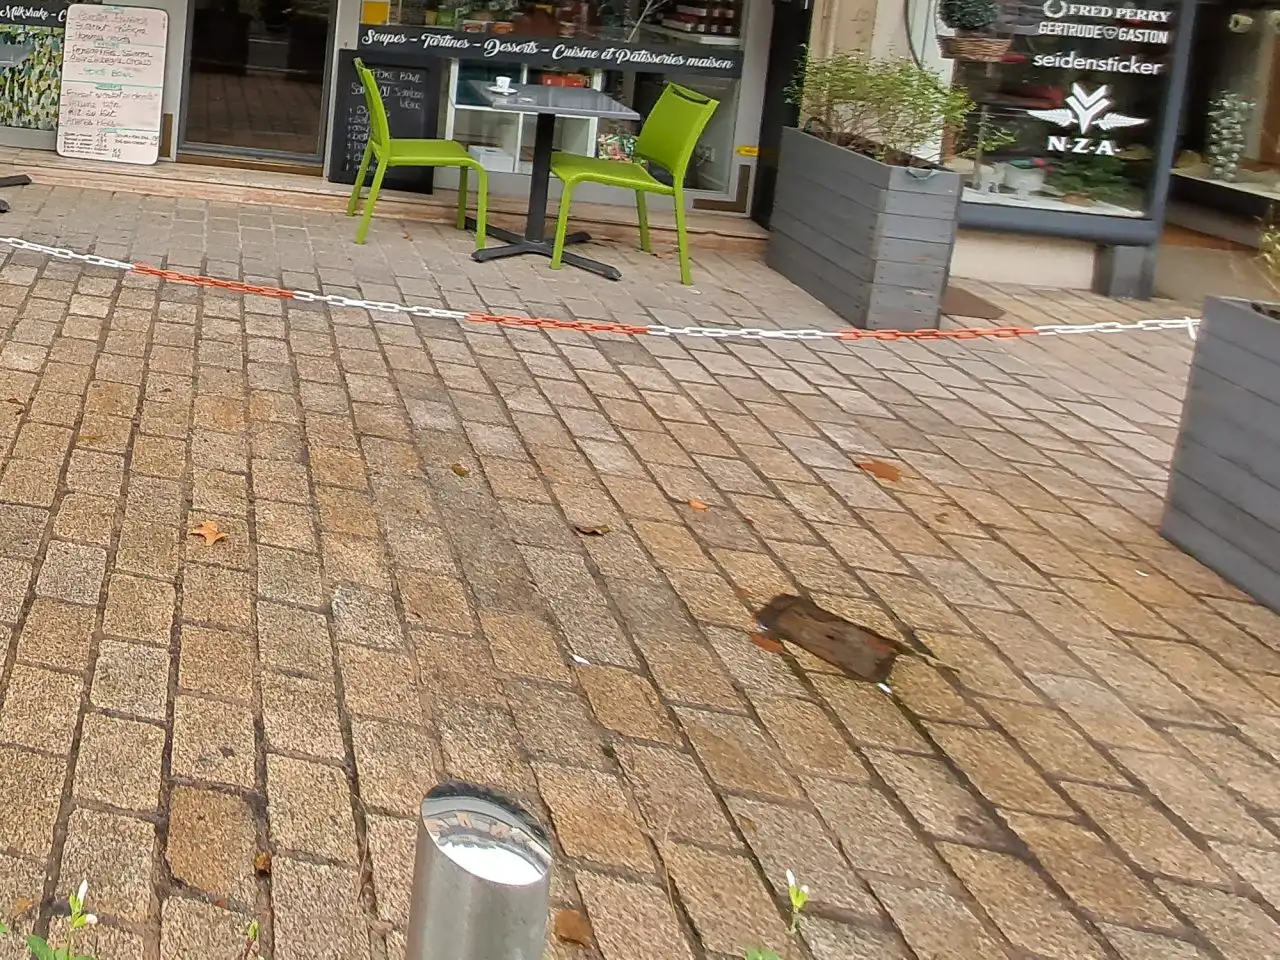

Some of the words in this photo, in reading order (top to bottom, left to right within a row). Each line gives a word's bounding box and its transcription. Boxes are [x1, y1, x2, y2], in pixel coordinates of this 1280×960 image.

[0, 5, 49, 21] Milkshake
[1068, 3, 1113, 18] FRED
[1114, 7, 1172, 23] PERRY
[1038, 21, 1104, 39] GERTRUDE
[1119, 27, 1169, 45] GASTON
[361, 28, 407, 46] Soupes
[420, 33, 470, 50] Tartines
[483, 38, 538, 57] Desserts
[552, 44, 598, 62] Cuisine
[600, 47, 614, 60] et
[686, 57, 734, 70] maison
[1032, 51, 1166, 75] seidensticker
